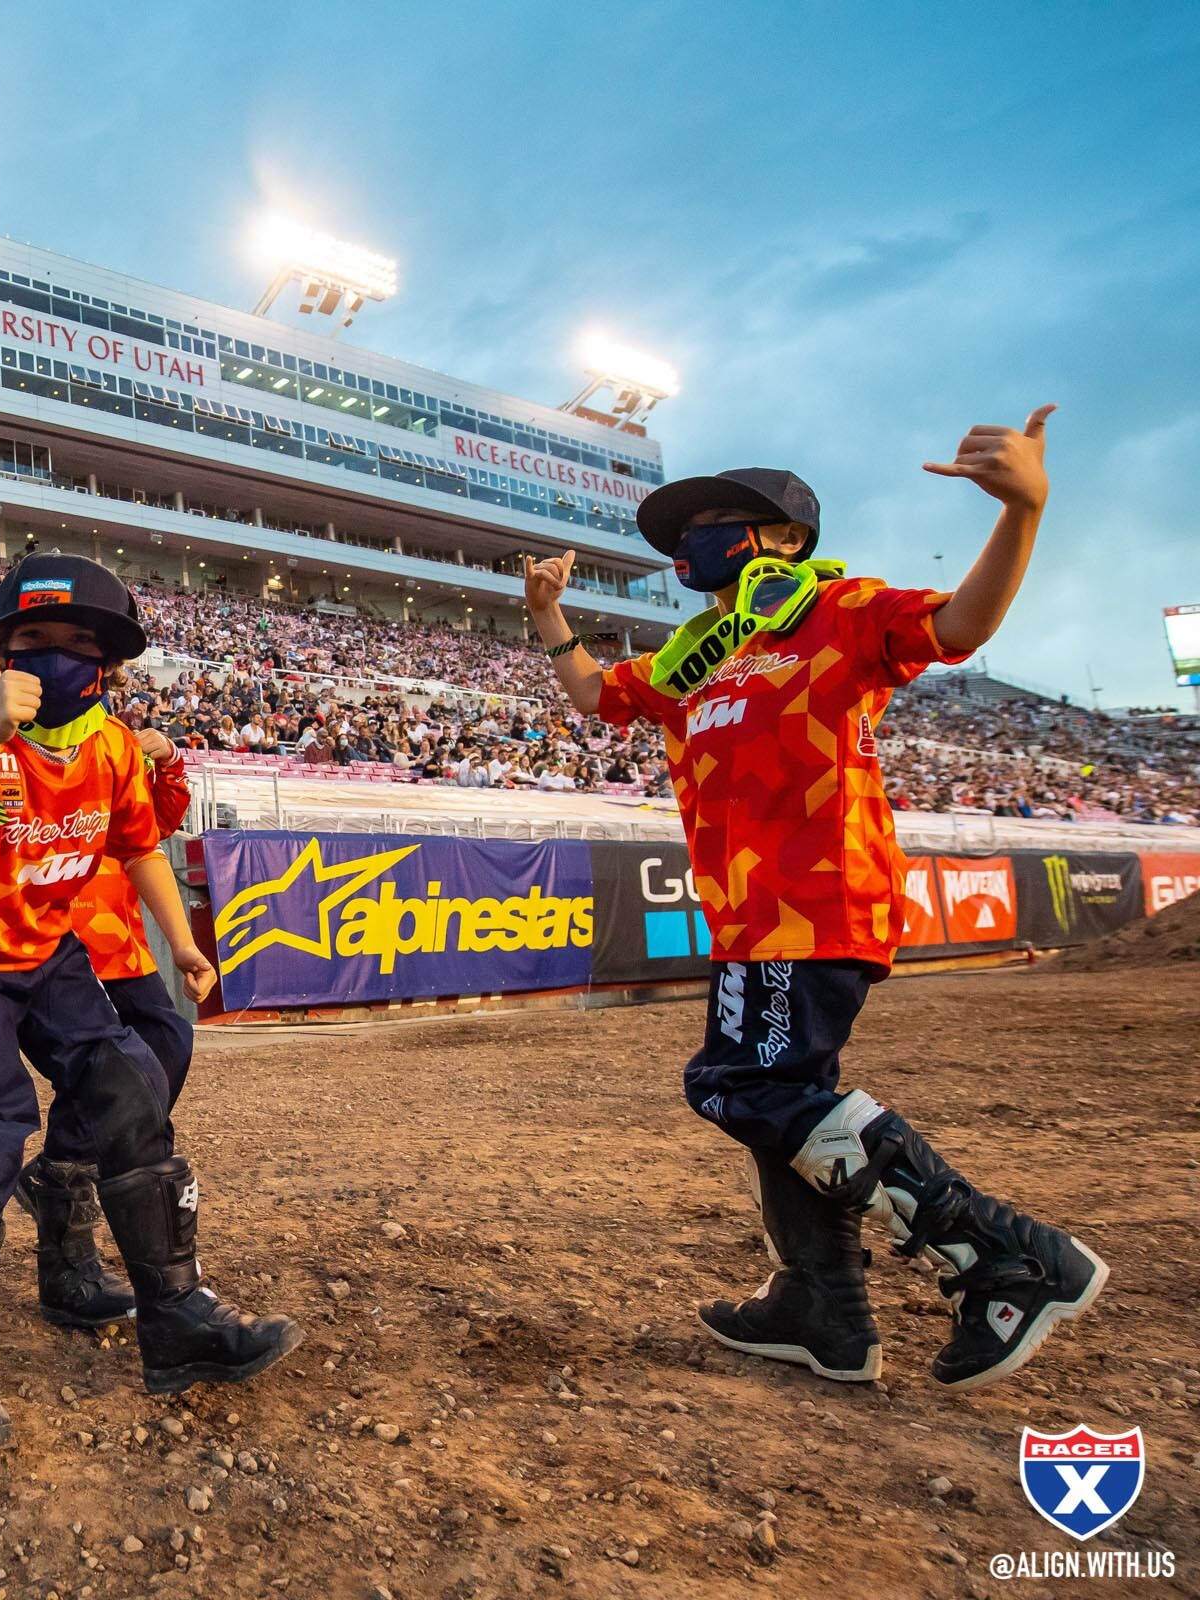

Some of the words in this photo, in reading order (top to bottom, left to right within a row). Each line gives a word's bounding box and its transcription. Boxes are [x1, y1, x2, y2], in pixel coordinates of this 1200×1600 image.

[87, 335, 125, 364] OF
[133, 346, 205, 387] UTAH
[454, 435, 577, 486] RICE-ECCLES
[666, 612, 757, 694] 100%
[686, 695, 748, 739] KTM
[60, 809, 110, 844] Design
[16, 850, 95, 886] KTM
[335, 880, 594, 975] alpinestars
[716, 961, 748, 1045] KTM
